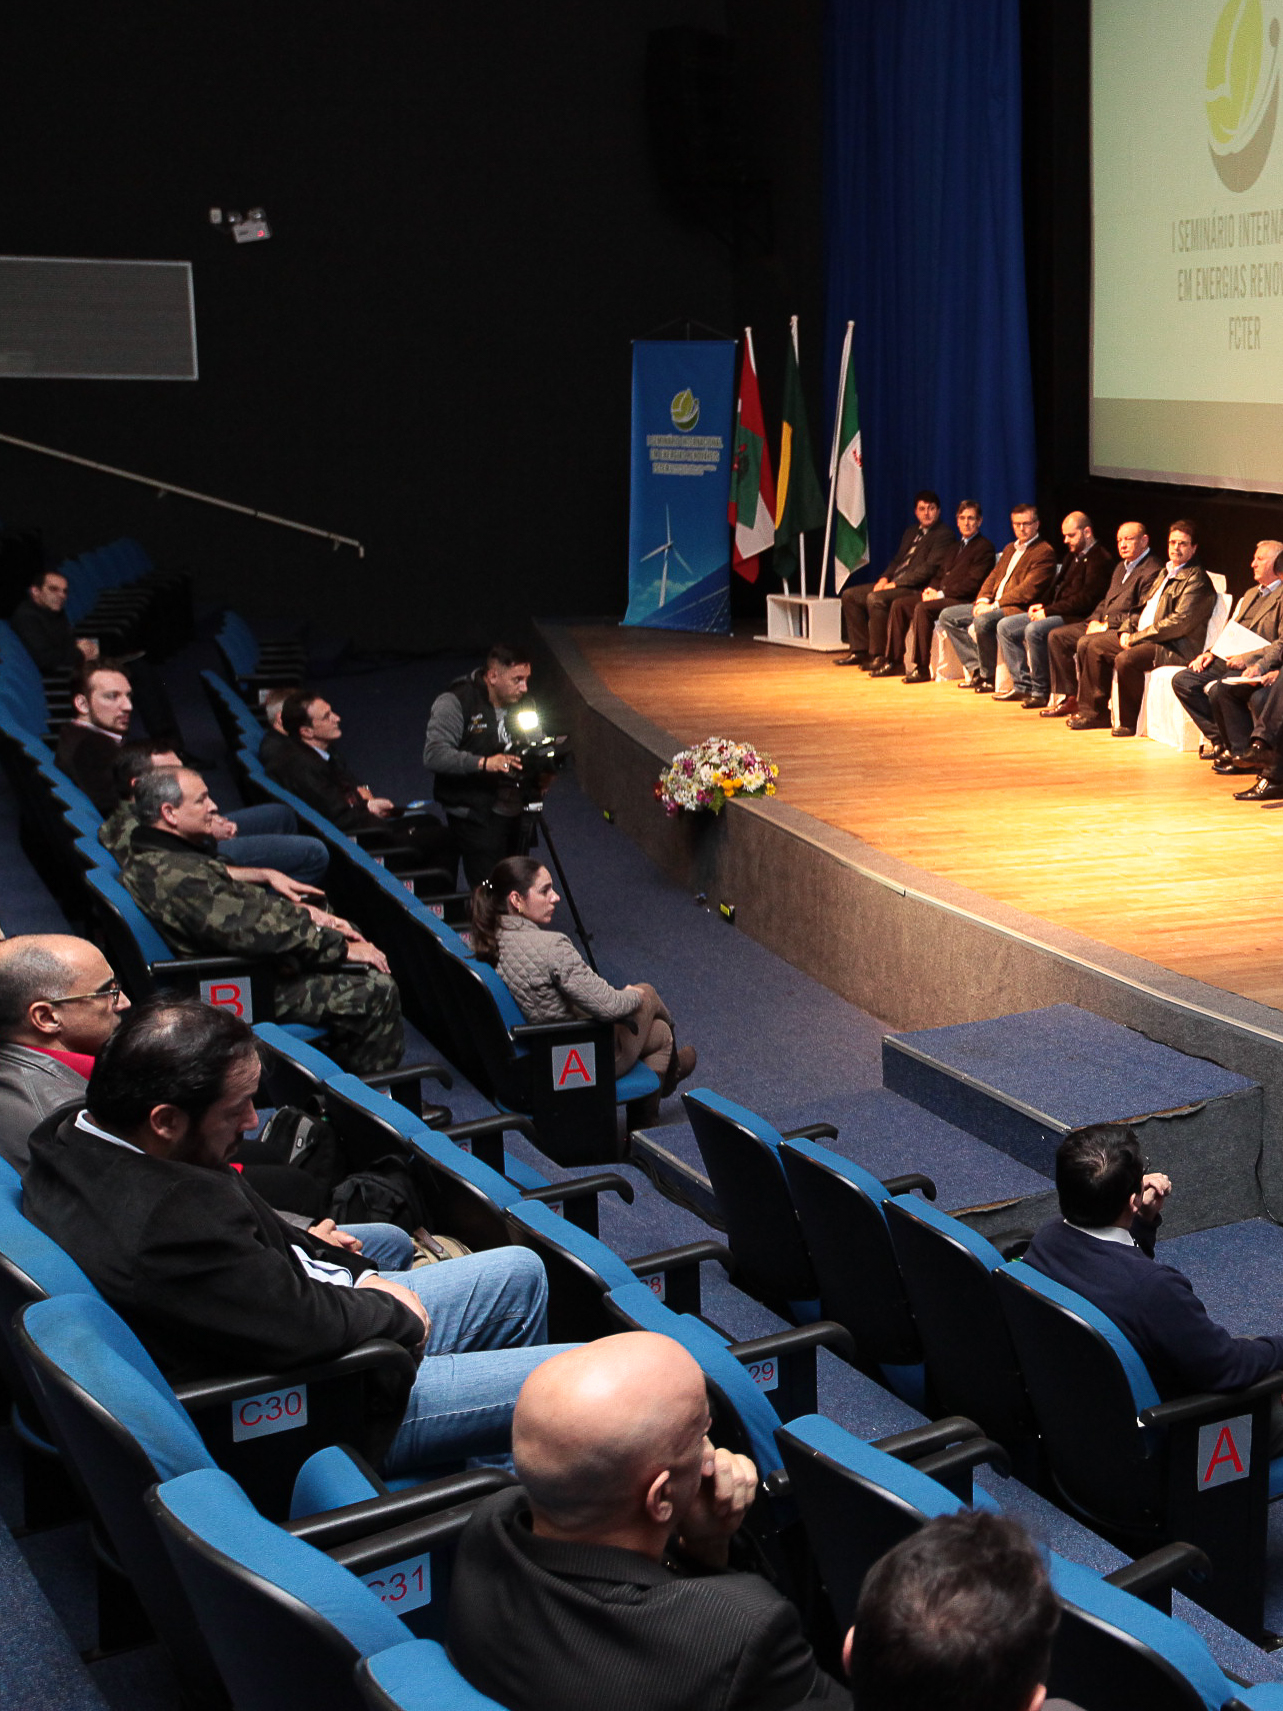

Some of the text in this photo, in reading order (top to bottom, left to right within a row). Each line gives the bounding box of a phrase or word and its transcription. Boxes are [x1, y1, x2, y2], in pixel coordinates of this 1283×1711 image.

[1178, 208, 1235, 253] SEMINÁRIO
[1177, 267, 1193, 302] EM
[1196, 263, 1247, 301] ENERGIAS
[1228, 316, 1261, 351] FCTER
[558, 1049, 592, 1086] A
[238, 1390, 302, 1427] C30
[1203, 1426, 1244, 1482] A
